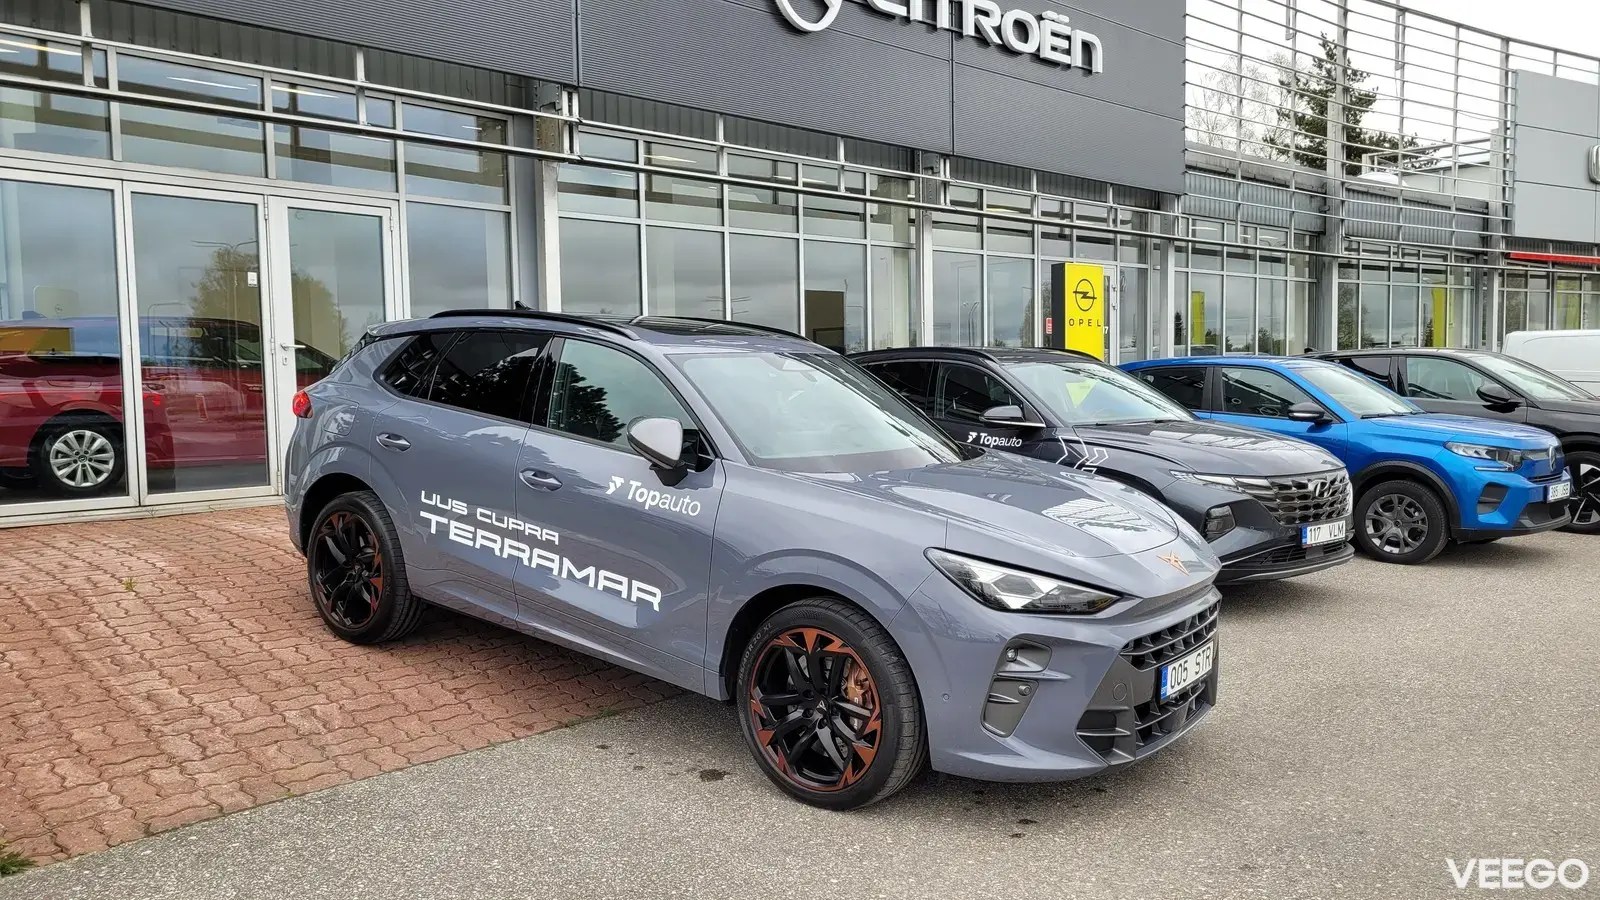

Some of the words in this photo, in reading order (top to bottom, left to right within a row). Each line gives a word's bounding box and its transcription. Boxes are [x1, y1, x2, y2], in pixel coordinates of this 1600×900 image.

[1068, 318, 1101, 327] OPEL
[979, 433, 1023, 448] Topauto
[627, 480, 701, 516] Topauto
[420, 490, 468, 516] UUS
[476, 507, 559, 545] CUPRA
[1309, 526, 1321, 542] 117
[1328, 522, 1344, 538] VLM
[420, 511, 662, 612] TERRAMAR
[1170, 659, 1189, 690] 005
[1195, 645, 1212, 676] STR
